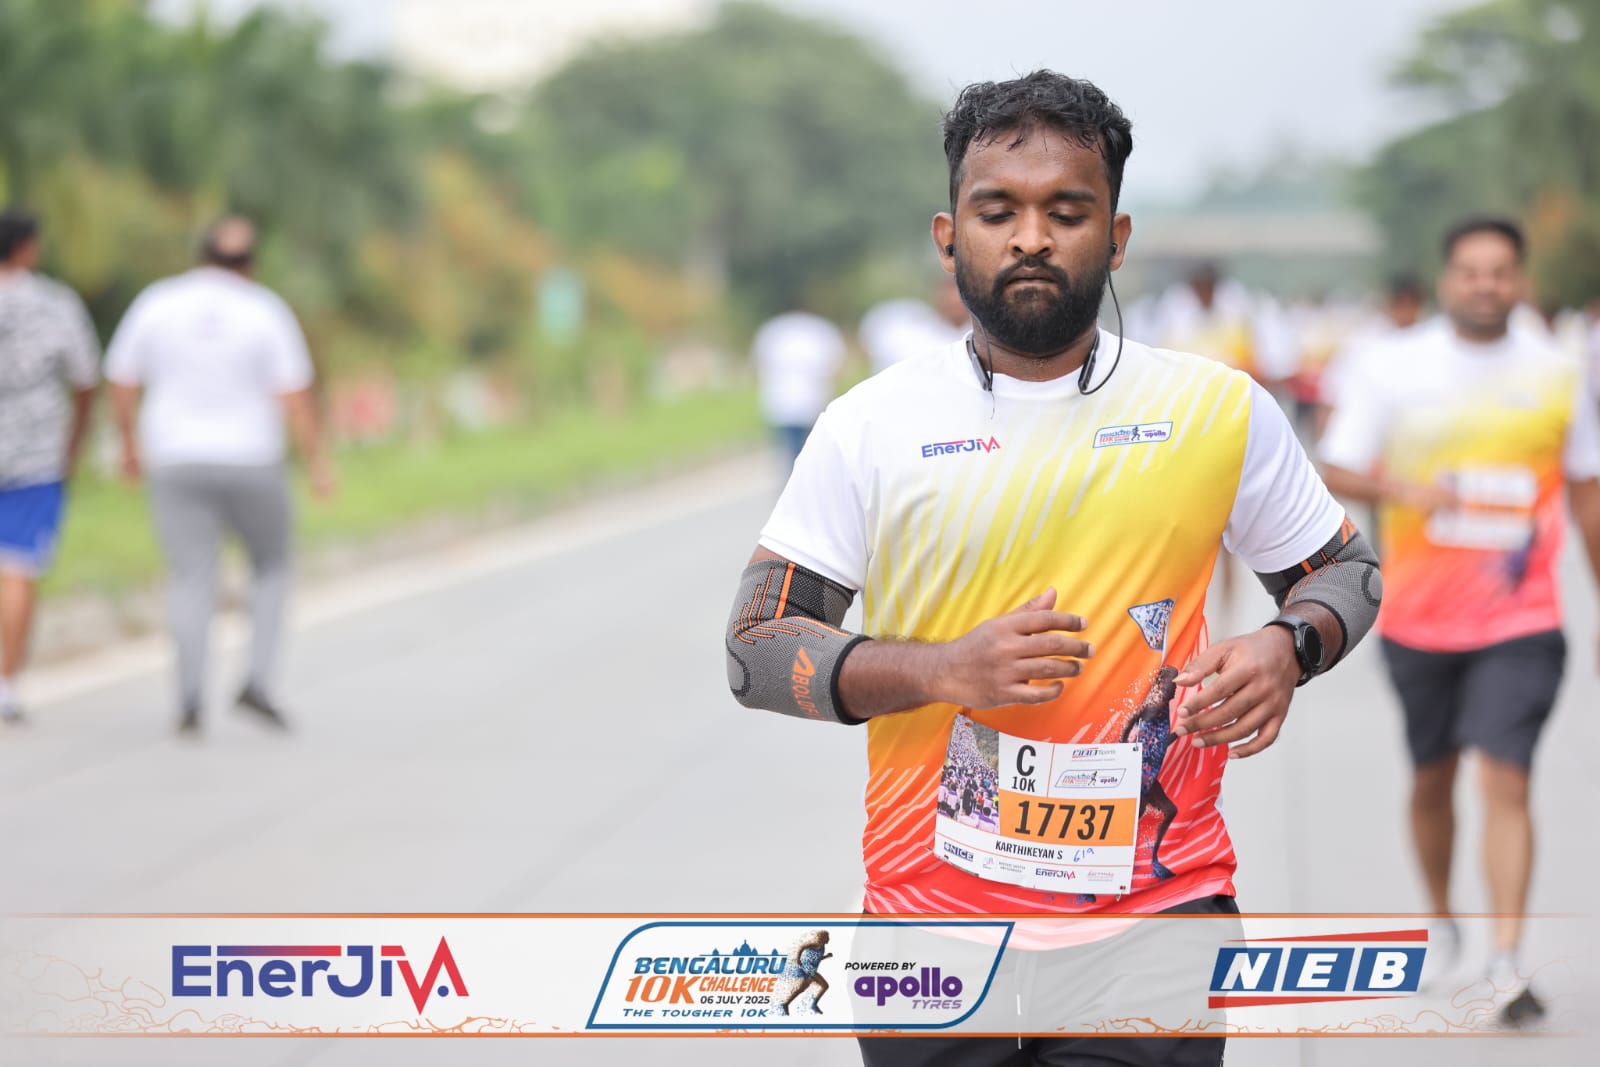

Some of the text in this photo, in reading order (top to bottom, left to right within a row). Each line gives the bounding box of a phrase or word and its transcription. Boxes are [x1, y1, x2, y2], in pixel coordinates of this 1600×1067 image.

[1016, 744, 1036, 776] C
[1011, 776, 1036, 793] 10K
[1014, 800, 1115, 840] 17737
[995, 840, 1064, 860] KARTHIKEYAN S
